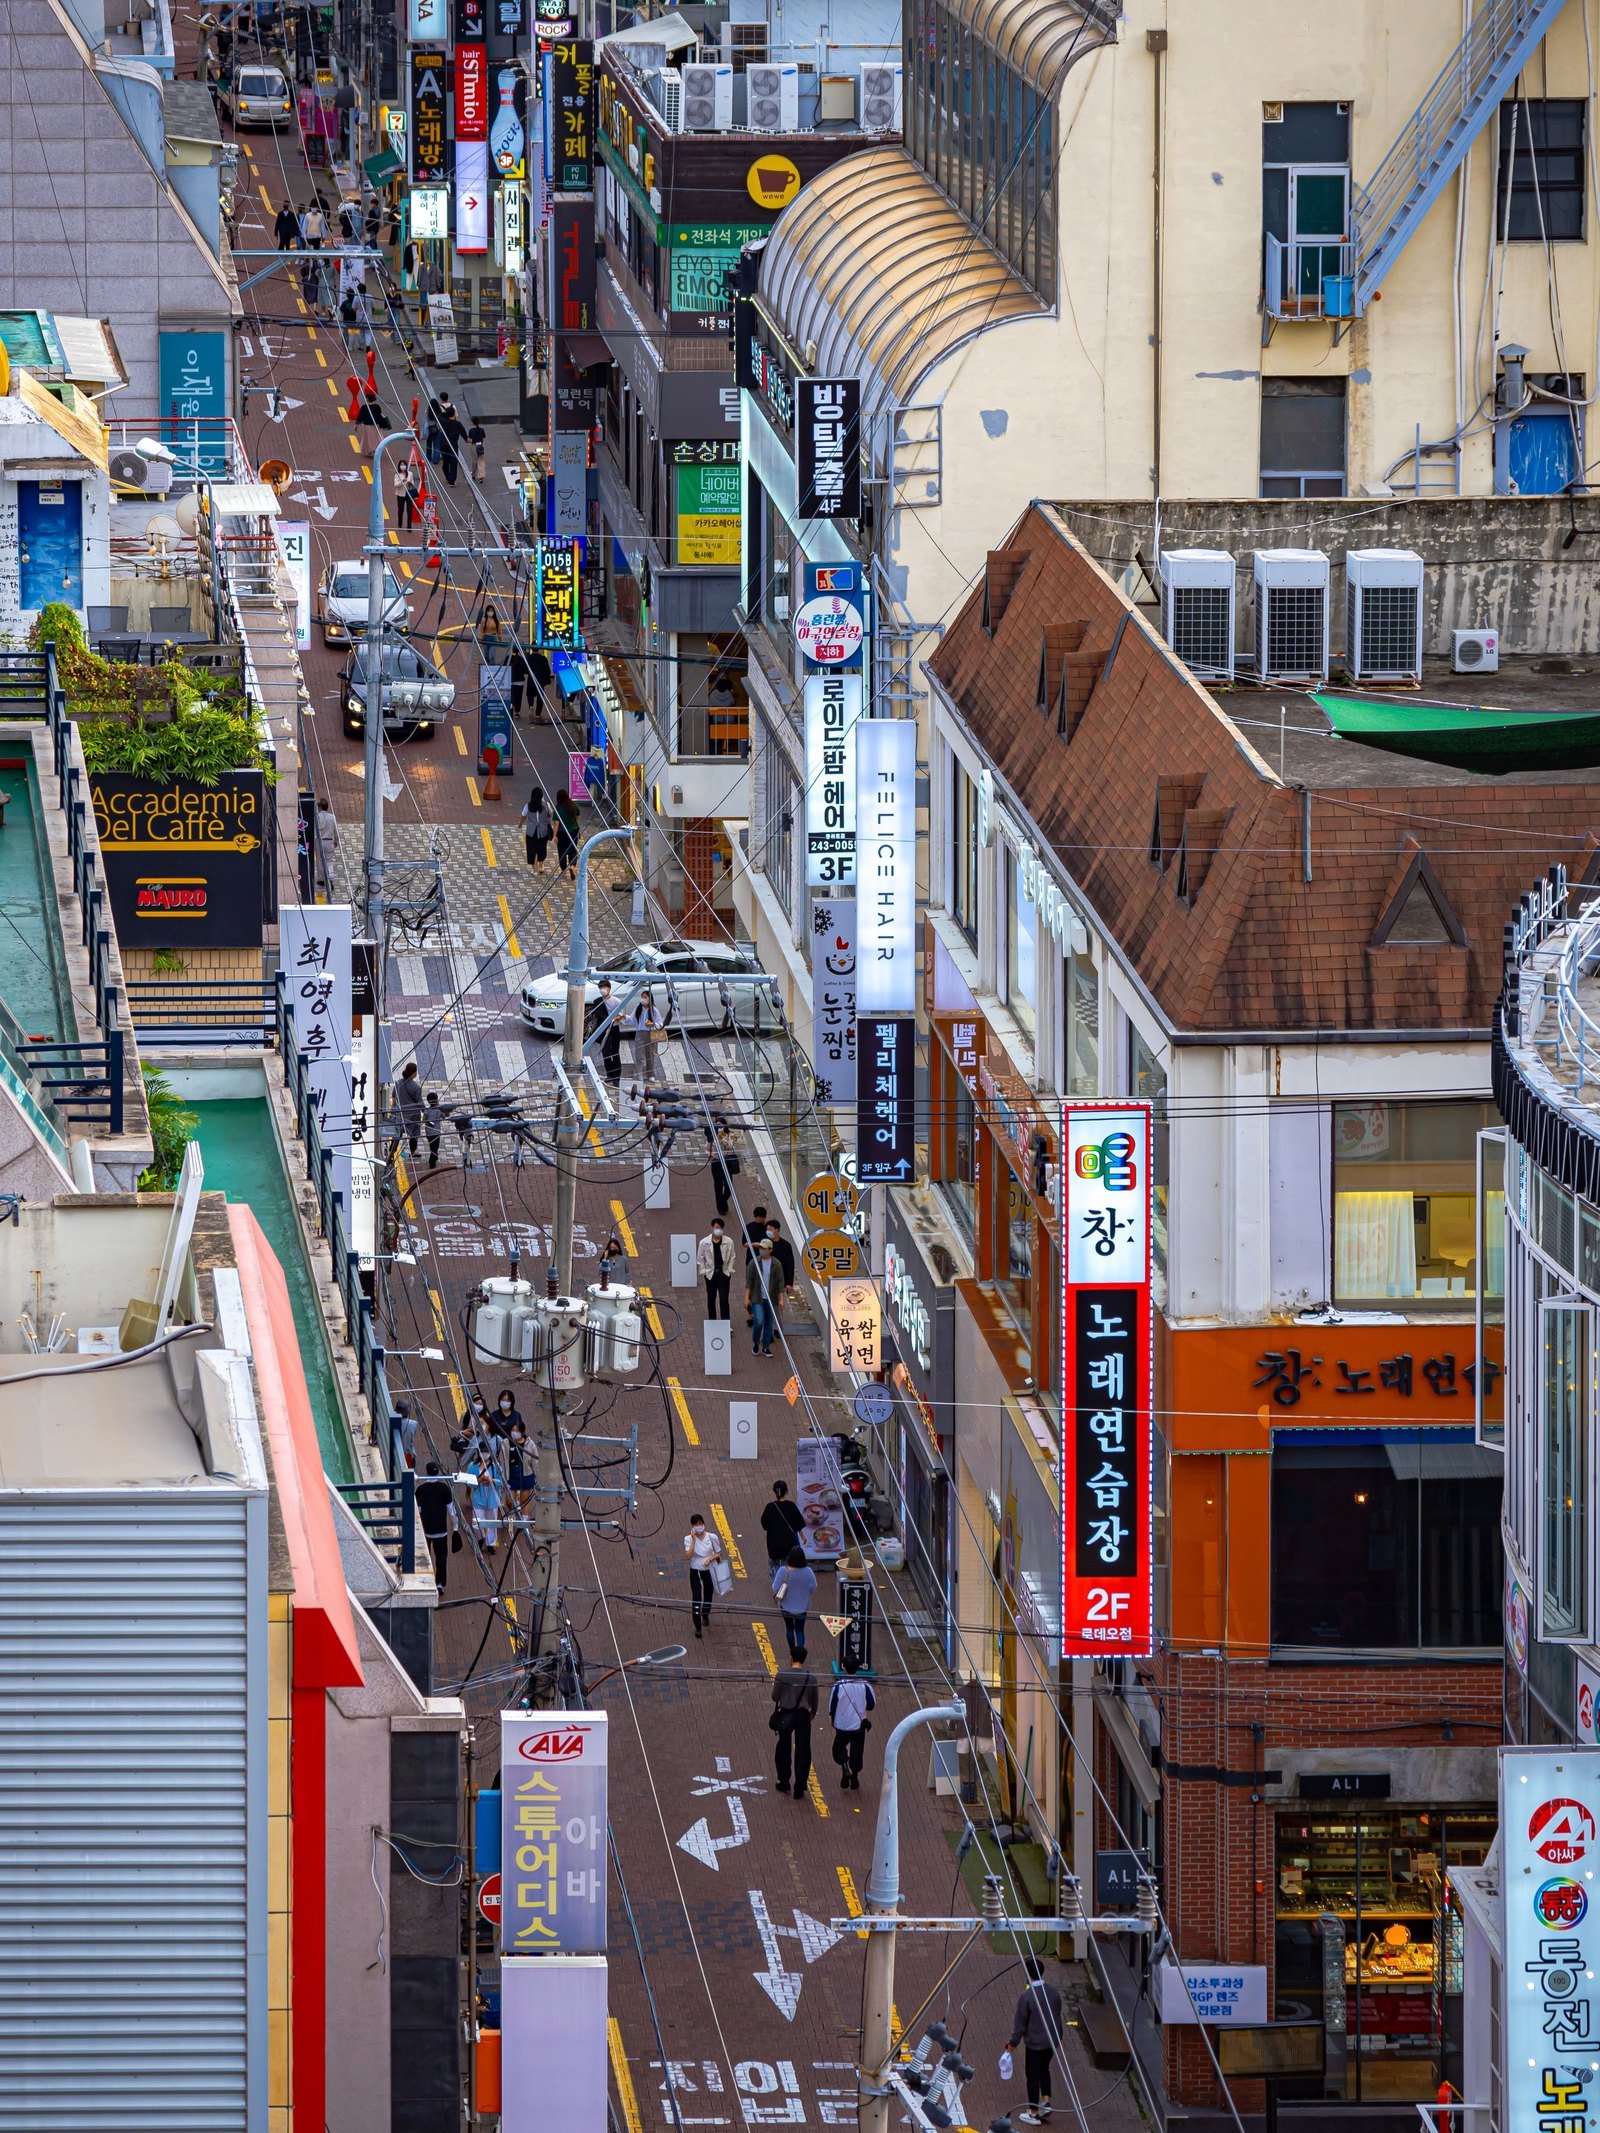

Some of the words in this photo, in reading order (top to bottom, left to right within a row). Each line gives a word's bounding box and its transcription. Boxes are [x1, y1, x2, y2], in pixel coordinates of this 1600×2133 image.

[466, 3, 477, 14] B1
[502, 23, 518, 34] 4F
[537, 24, 568, 35] ROCK
[462, 50, 480, 59] hair
[416, 70, 443, 99] A
[463, 60, 479, 119] STmio
[562, 96, 586, 106] 전용
[419, 101, 443, 165] 노래방
[564, 111, 587, 158] 카페
[500, 156, 513, 166] 3F
[506, 189, 519, 252] 사진관
[691, 228, 731, 245] 전좌석
[558, 388, 594, 399] 탤런트
[562, 399, 590, 410] 헤어
[813, 384, 846, 495] 방탈출
[701, 492, 739, 504] 예약할인
[820, 500, 840, 513] 4F
[560, 508, 581, 520] 설빙
[283, 536, 304, 562] 진
[545, 553, 571, 567] 015B
[545, 568, 571, 631] 노래방
[798, 626, 860, 639] 야구연습장
[820, 646, 840, 657] 지하
[823, 680, 846, 774] 로이드밤
[91, 785, 255, 814] Accademia
[824, 781, 845, 828] 헤어
[147, 811, 224, 840] Caffè
[877, 772, 895, 877] FELICE
[819, 857, 853, 881] 3F
[137, 890, 207, 909] MAURO
[877, 892, 895, 961] HAIR
[297, 936, 333, 1057] 최영후
[876, 1023, 897, 1150] 펠리체헤어
[862, 1163, 872, 1172] 3F
[875, 1163, 892, 1173] 입구
[1081, 1207, 1126, 1256] 창
[808, 1247, 854, 1271] 양말
[836, 1318, 877, 1340] 육쌈
[837, 1344, 874, 1366] 냉면
[1253, 1348, 1312, 1406] 창
[1086, 1304, 1129, 1563] 노래연습장
[1086, 1588, 1130, 1621] 2F
[1081, 1627, 1132, 1641] 로데오점
[529, 1735, 583, 1755] AVA
[1332, 1780, 1360, 1790] ALI
[514, 1771, 562, 1947] 스튜어디스
[565, 1815, 601, 1904] 아바
[1548, 1848, 1575, 1862] 아싸
[1187, 1978, 1243, 1989] 산소투과성
[1552, 1976, 1566, 1985] 100
[1190, 1992, 1213, 2003] RGP
[1217, 1991, 1239, 2003] 렌즈
[1525, 1938, 1600, 2053] 동전
[1198, 2005, 1232, 2016] 전문점
